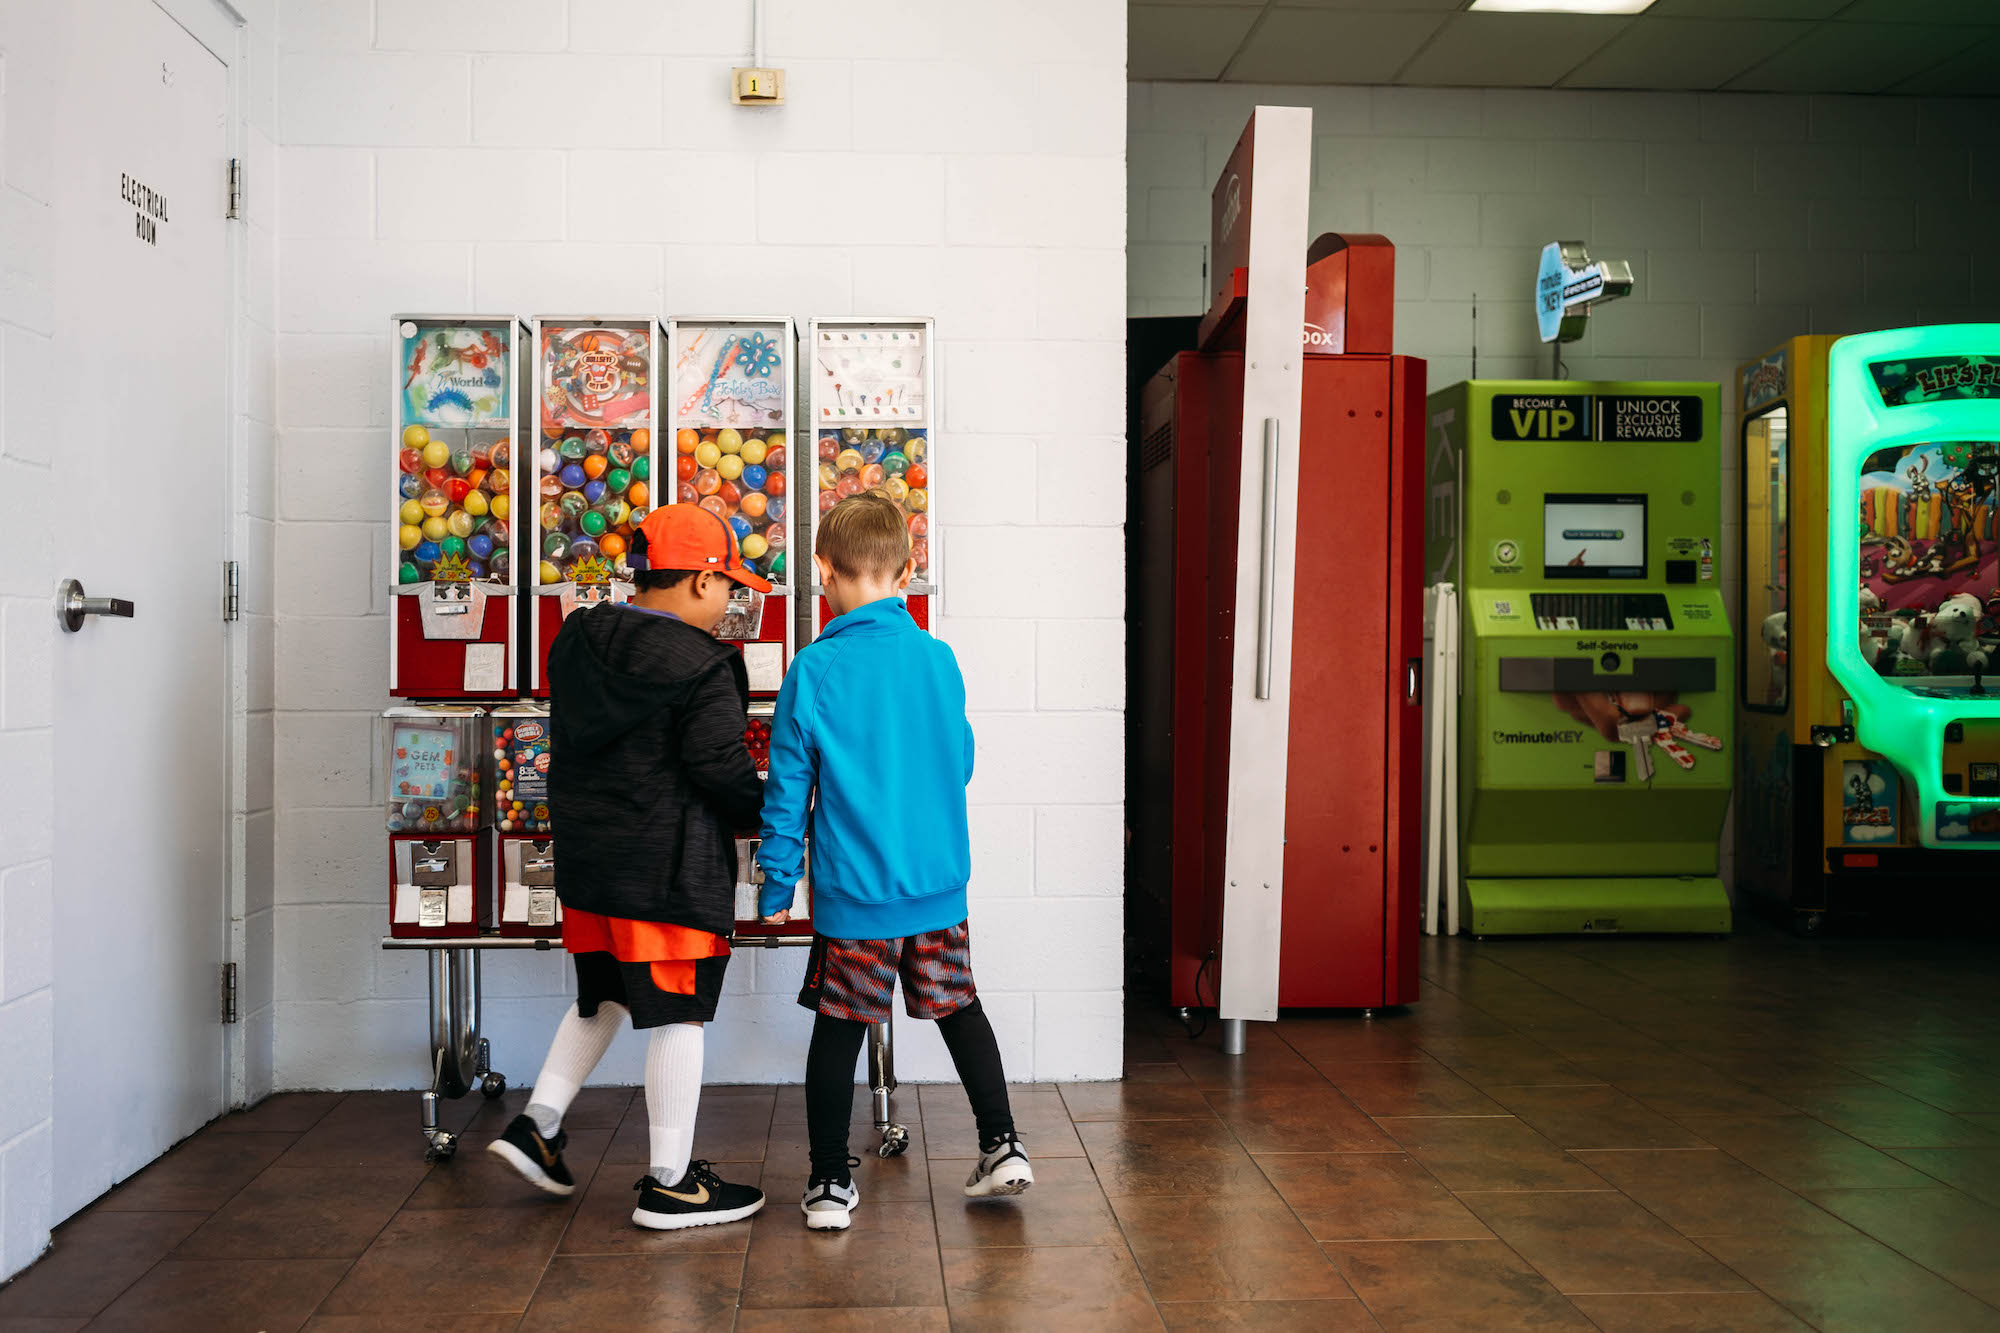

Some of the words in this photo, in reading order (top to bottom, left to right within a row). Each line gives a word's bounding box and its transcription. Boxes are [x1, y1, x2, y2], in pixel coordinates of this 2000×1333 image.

[752, 79, 757, 92] 1
[121, 172, 168, 222] ELECTRICAL
[136, 211, 156, 246] ROOM
[449, 376, 484, 387] World
[1512, 398, 1555, 409] BECOME
[1559, 399, 1568, 409] A
[1616, 400, 1681, 414] UNLOCK
[1509, 409, 1576, 439] VIP
[1616, 414, 1681, 426] EXCLUSIVE
[1616, 426, 1682, 439] REWARDS
[1576, 640, 1639, 651] Self-Service
[410, 751, 441, 761] GEM
[414, 762, 436, 771] PETS
[519, 766, 526, 775] 8
